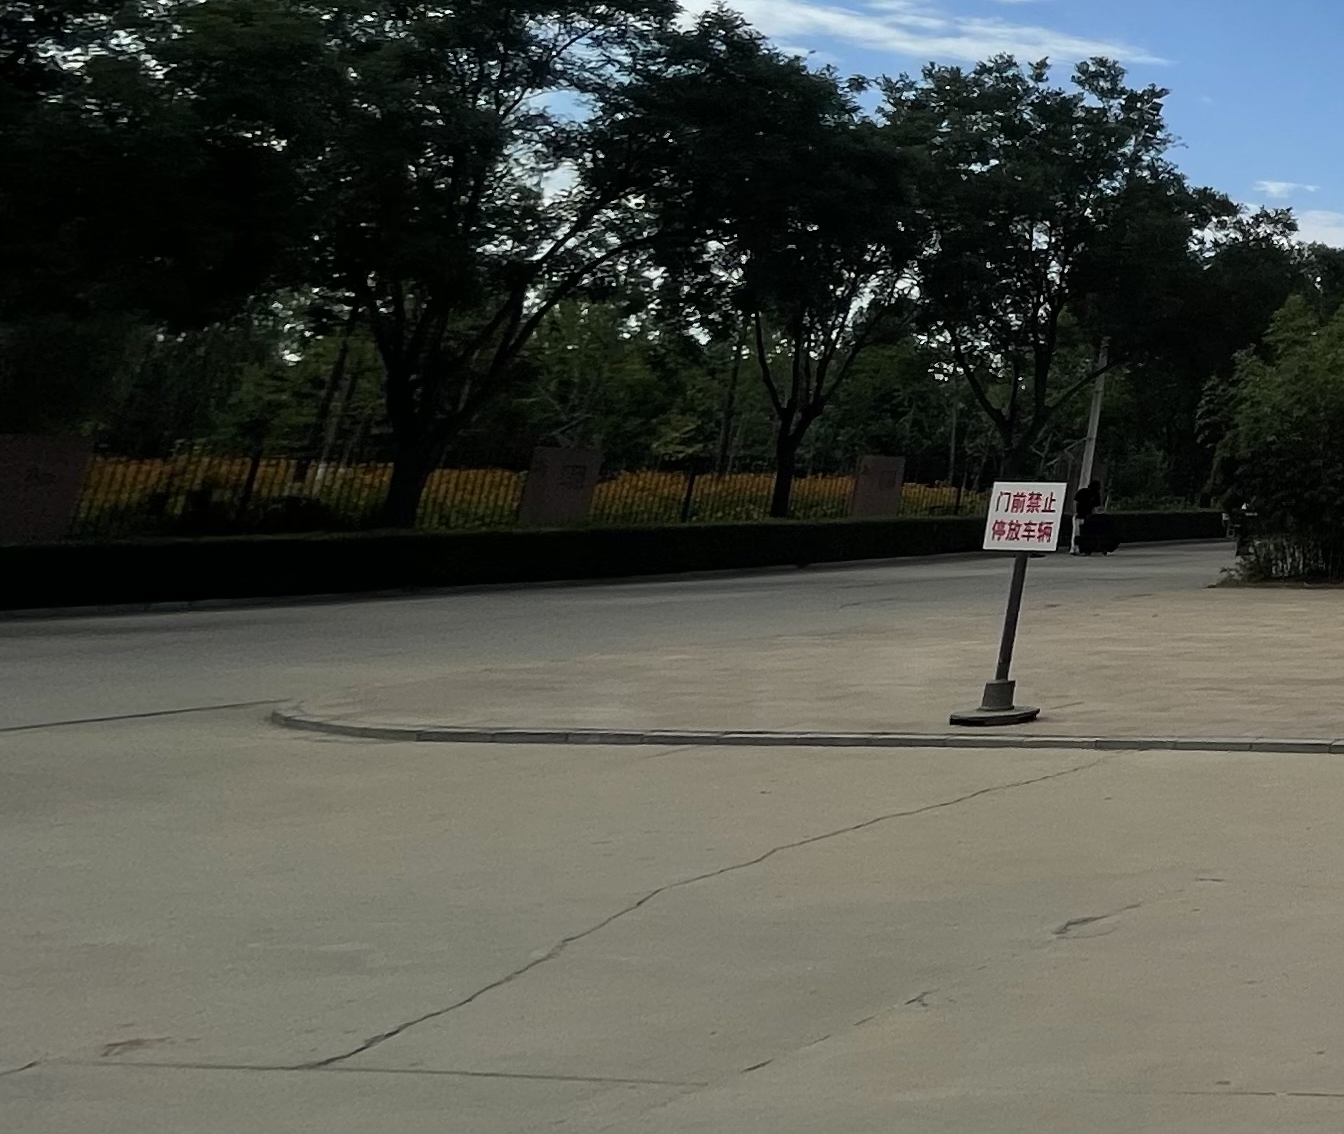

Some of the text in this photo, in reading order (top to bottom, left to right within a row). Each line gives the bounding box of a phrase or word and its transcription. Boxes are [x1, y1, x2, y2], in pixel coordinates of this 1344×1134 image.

[995, 490, 1057, 514] 门前禁止
[991, 519, 1054, 543] 停放车辆
